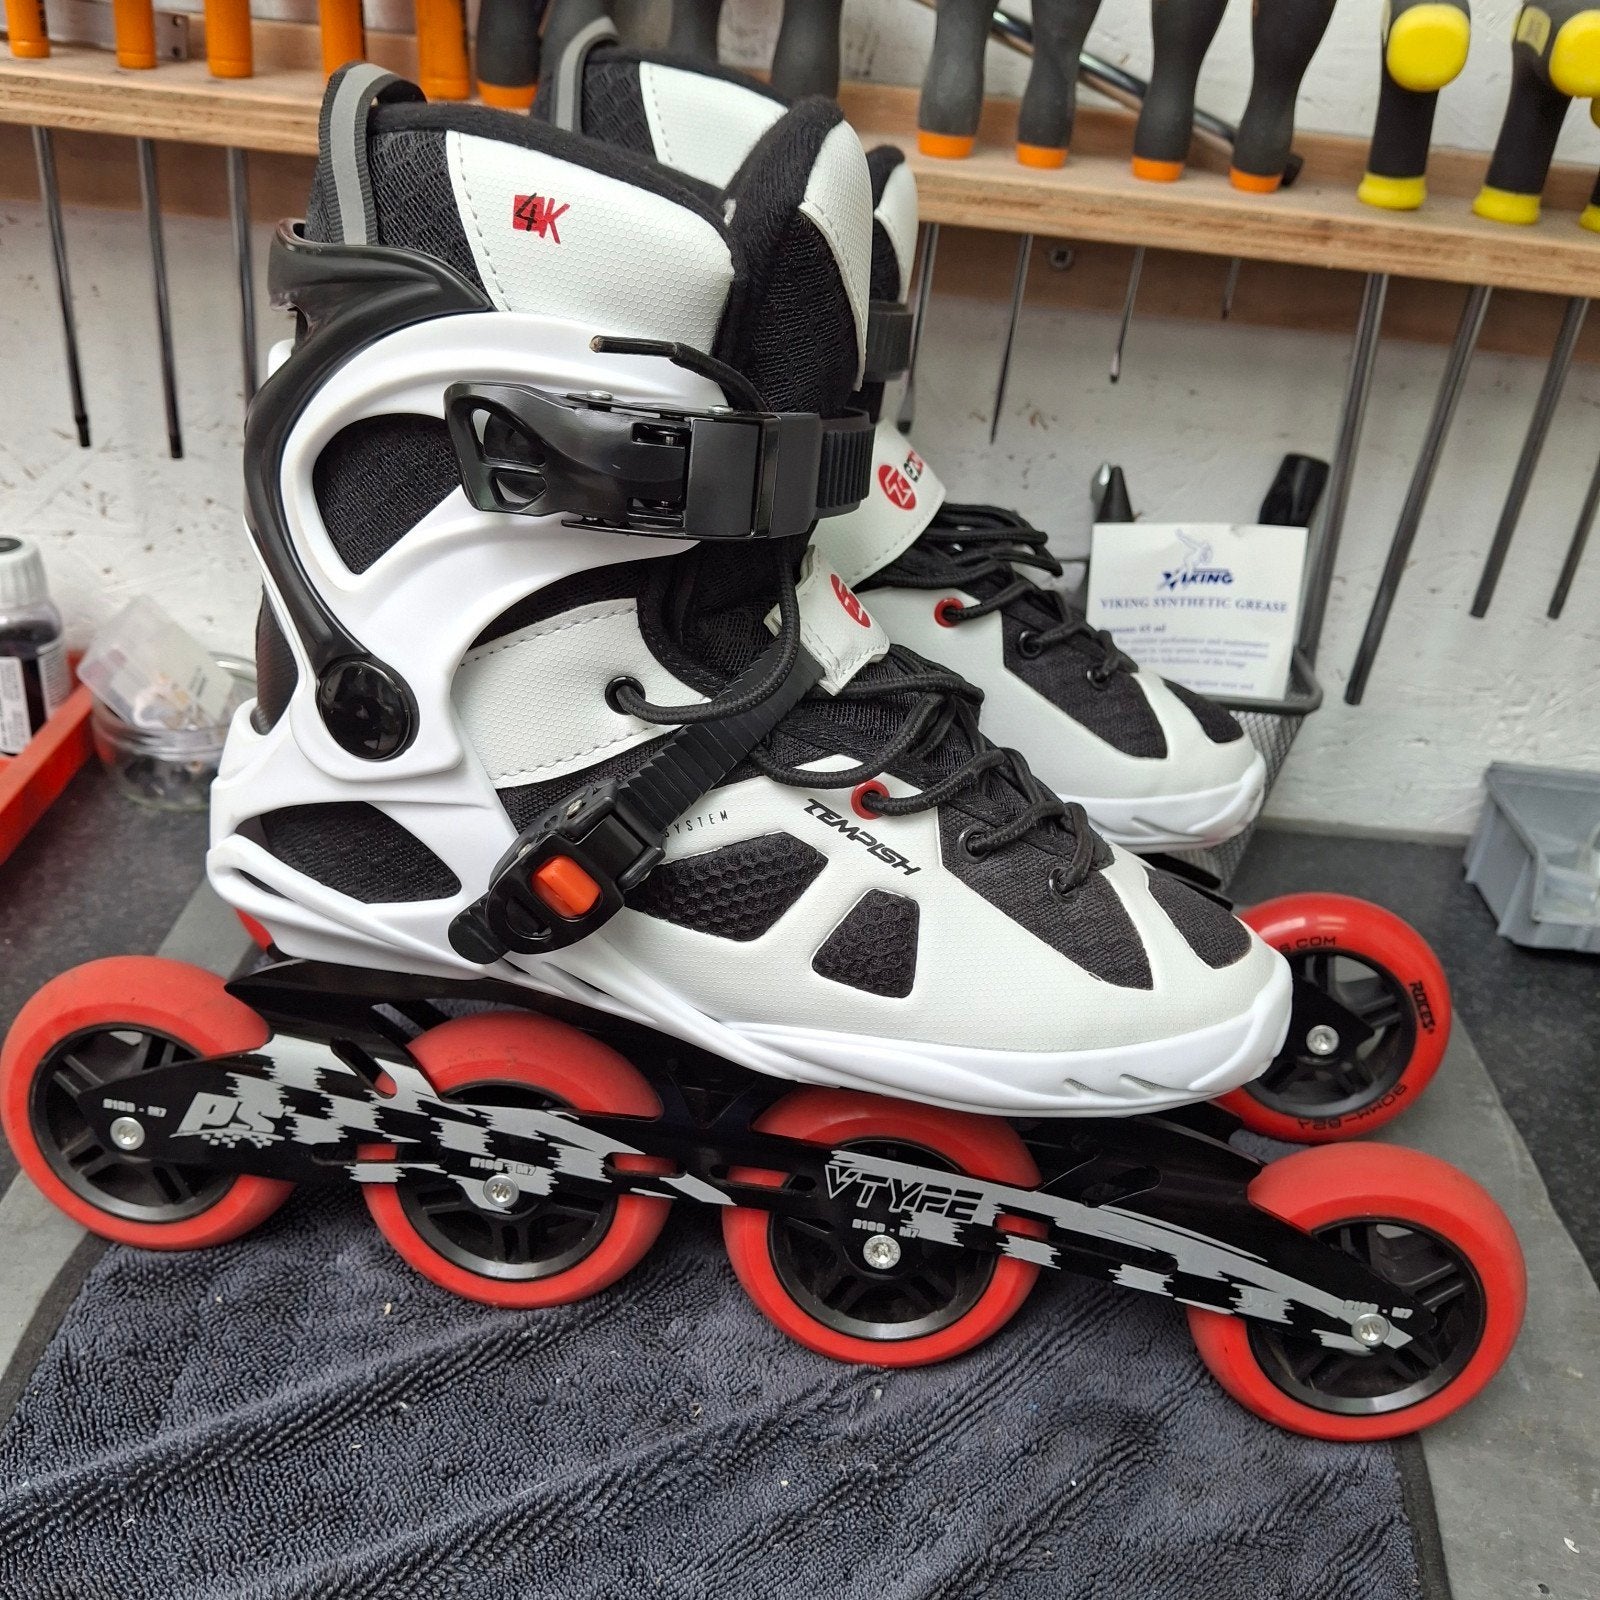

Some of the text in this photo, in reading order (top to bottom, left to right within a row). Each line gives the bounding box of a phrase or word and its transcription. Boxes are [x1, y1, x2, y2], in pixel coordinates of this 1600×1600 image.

[513, 193, 571, 244] 4K
[1158, 570, 1234, 590] VIKING
[1101, 597, 1288, 614] VIKING SYNTHETIC GREASE
[803, 798, 922, 876] TEMPISH
[1409, 980, 1436, 1029] ROCES
[825, 1164, 984, 1224] VTYPE
